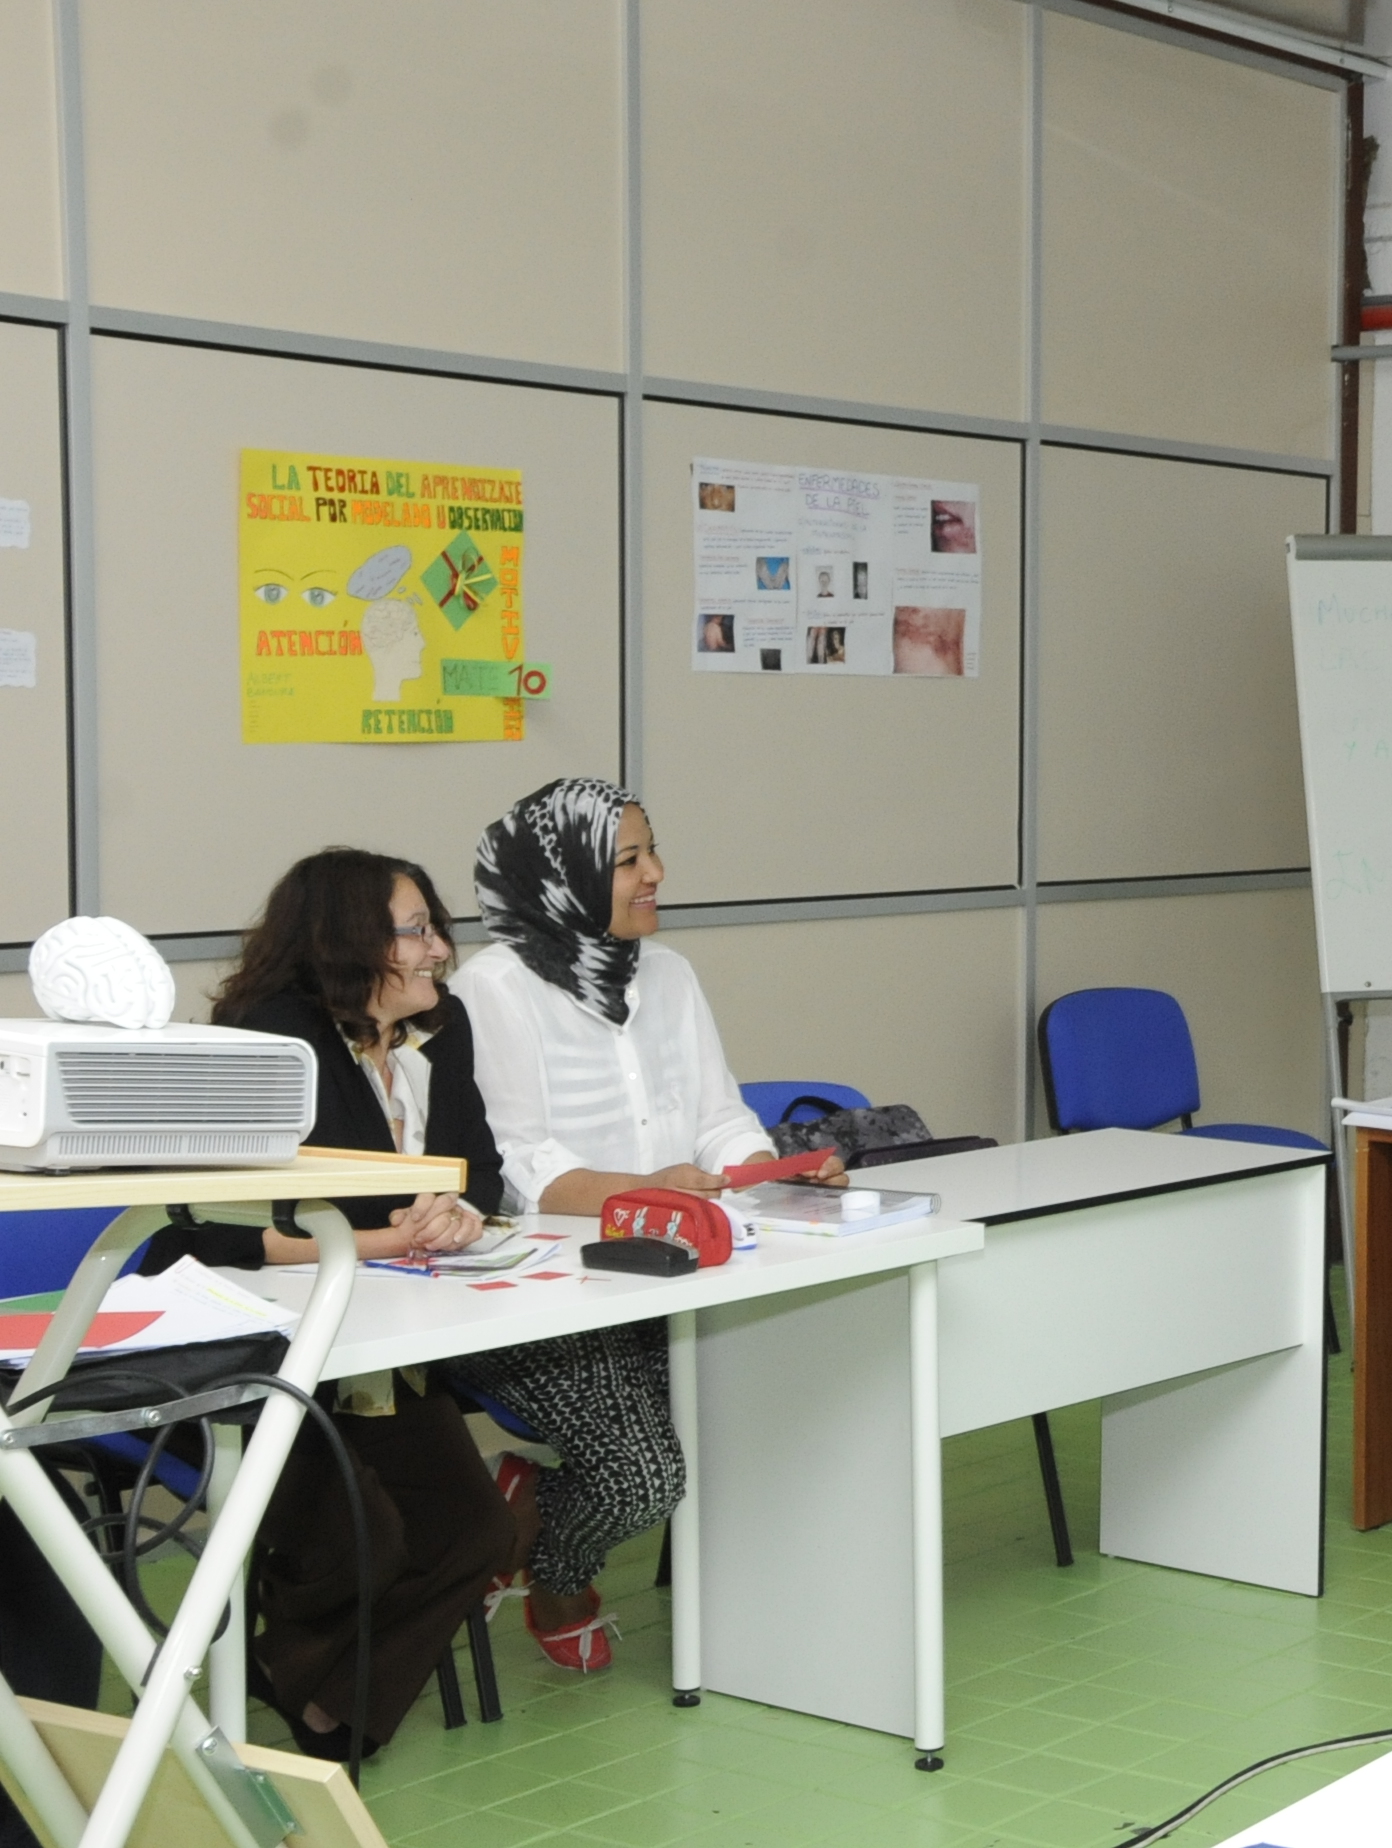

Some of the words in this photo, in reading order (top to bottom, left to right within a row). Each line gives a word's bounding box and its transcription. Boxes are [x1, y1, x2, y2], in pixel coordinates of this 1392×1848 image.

[271, 464, 301, 490] LA
[306, 465, 380, 495] TEORIA
[386, 470, 415, 498] DEL
[246, 493, 311, 521] SOCIAL
[315, 497, 347, 522] POR
[351, 500, 431, 528] MODELADO
[508, 663, 547, 696] 10
